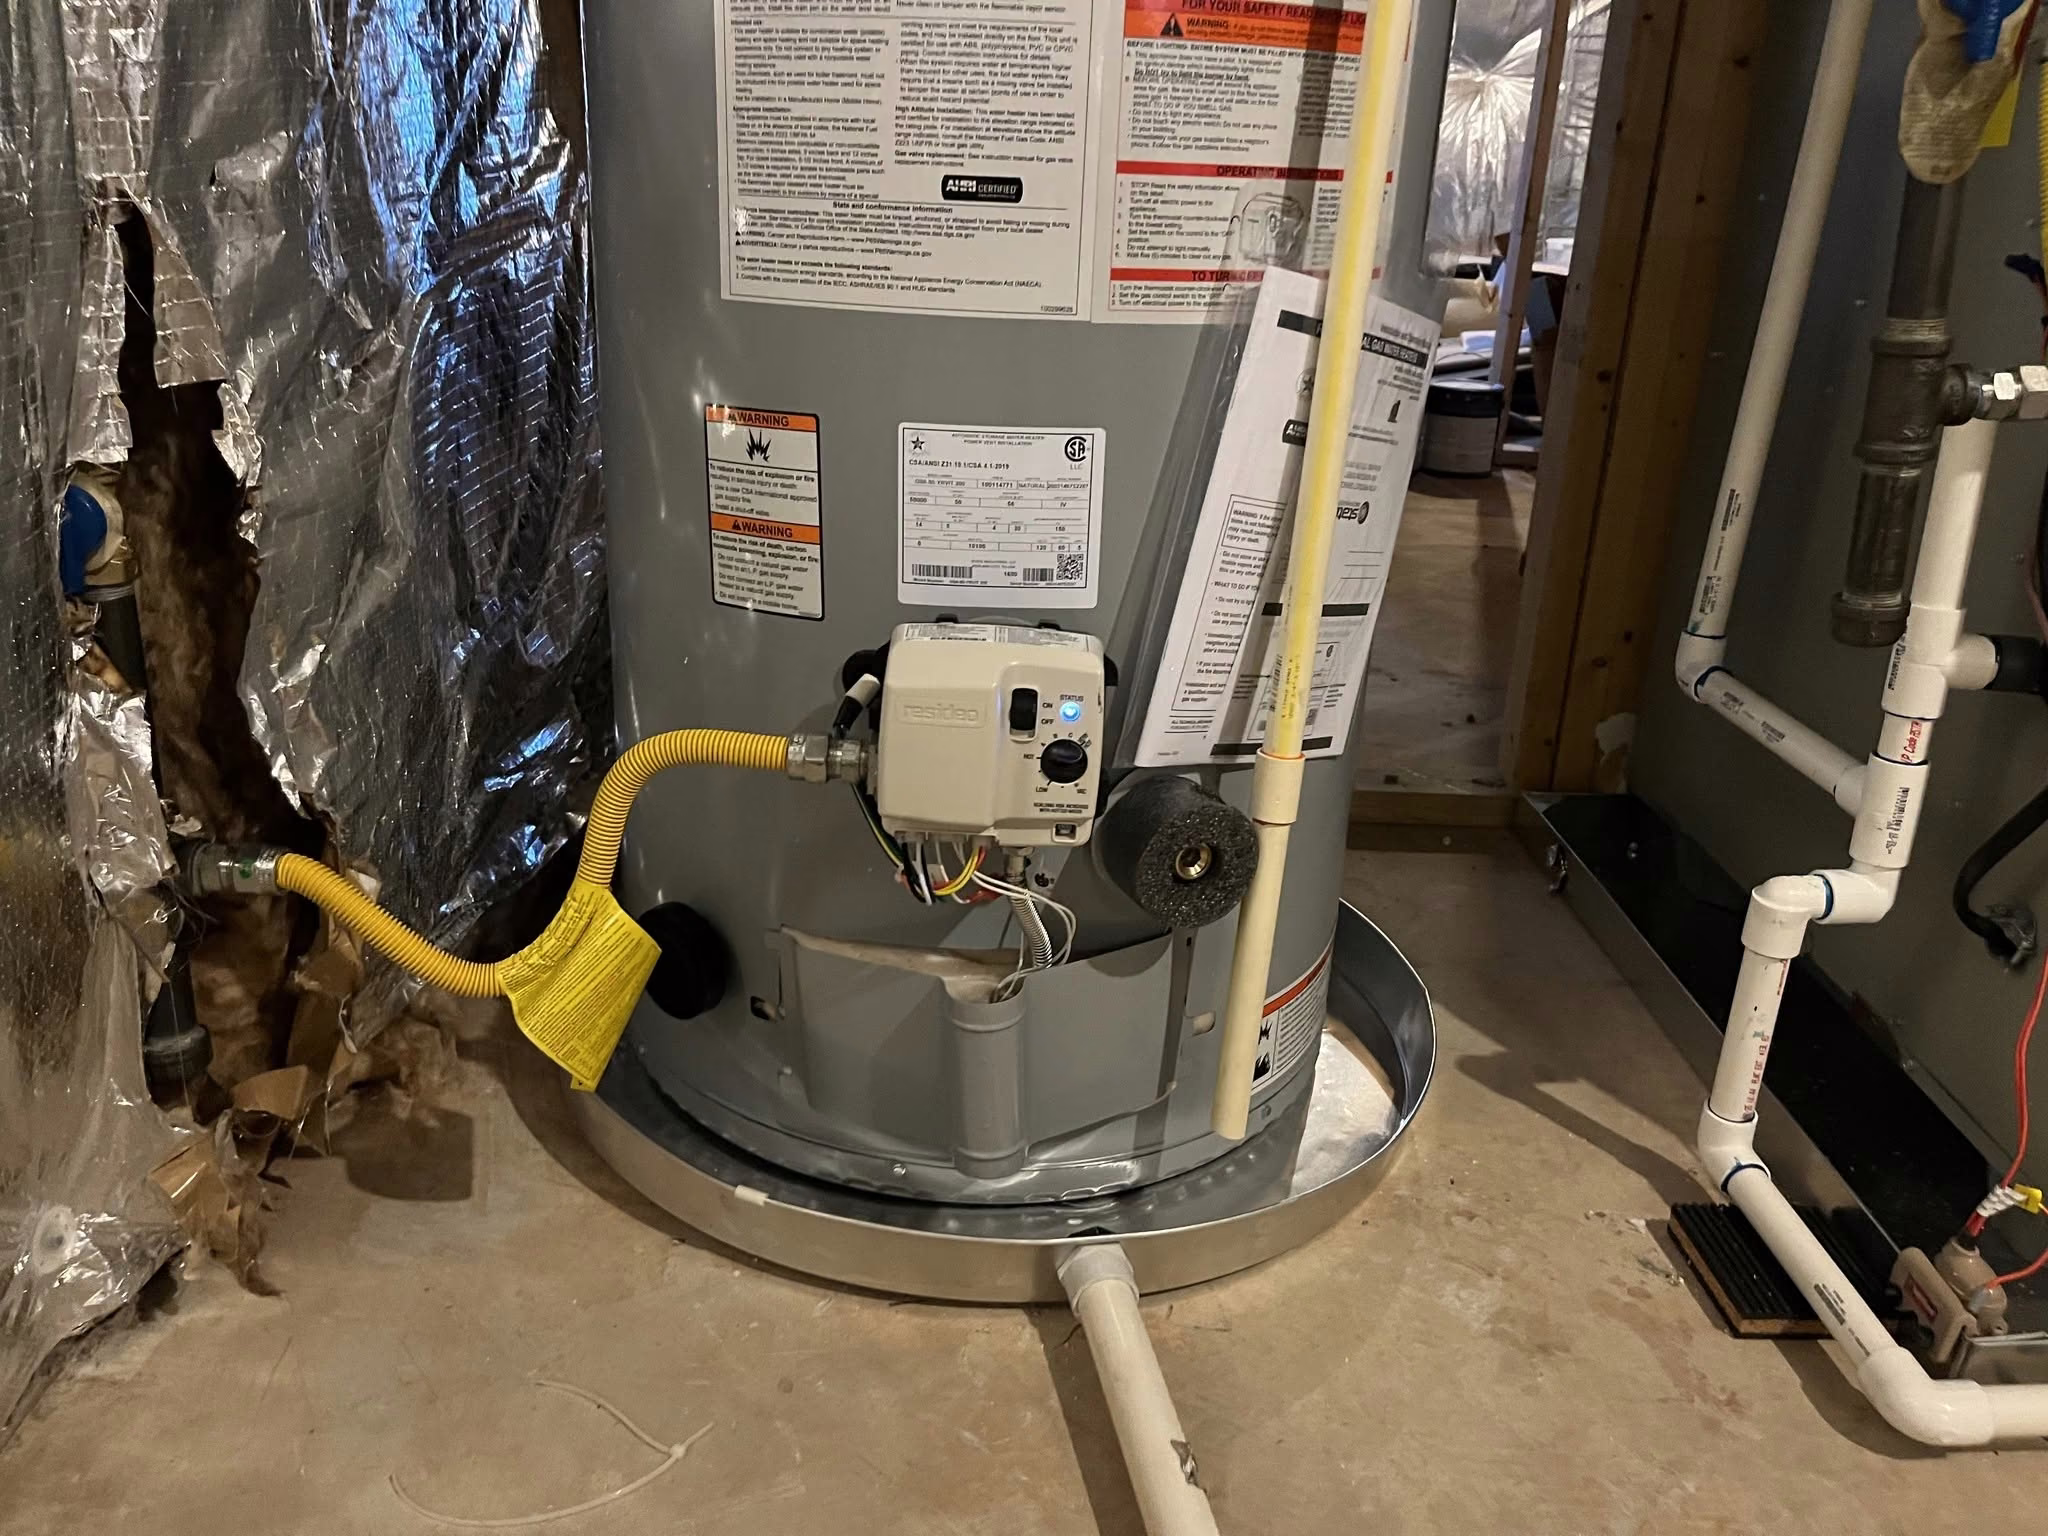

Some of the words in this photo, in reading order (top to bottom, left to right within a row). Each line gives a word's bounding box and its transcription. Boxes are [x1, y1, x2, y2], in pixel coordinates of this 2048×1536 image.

[1243, 0, 1286, 17] SAFETY
[945, 179, 976, 192] AHRI
[978, 184, 1017, 194] CERTIFIED
[832, 201, 849, 209] State
[851, 202, 864, 210] and
[865, 202, 910, 212] conformance
[911, 204, 953, 214] information
[1192, 271, 1208, 282] TO
[736, 412, 790, 427] WARNING
[1064, 436, 1087, 462] CSA
[742, 521, 793, 538] WARNING
[1060, 694, 1084, 702] STATUS
[903, 703, 979, 722] resideo
[1904, 737, 1917, 753] Code
